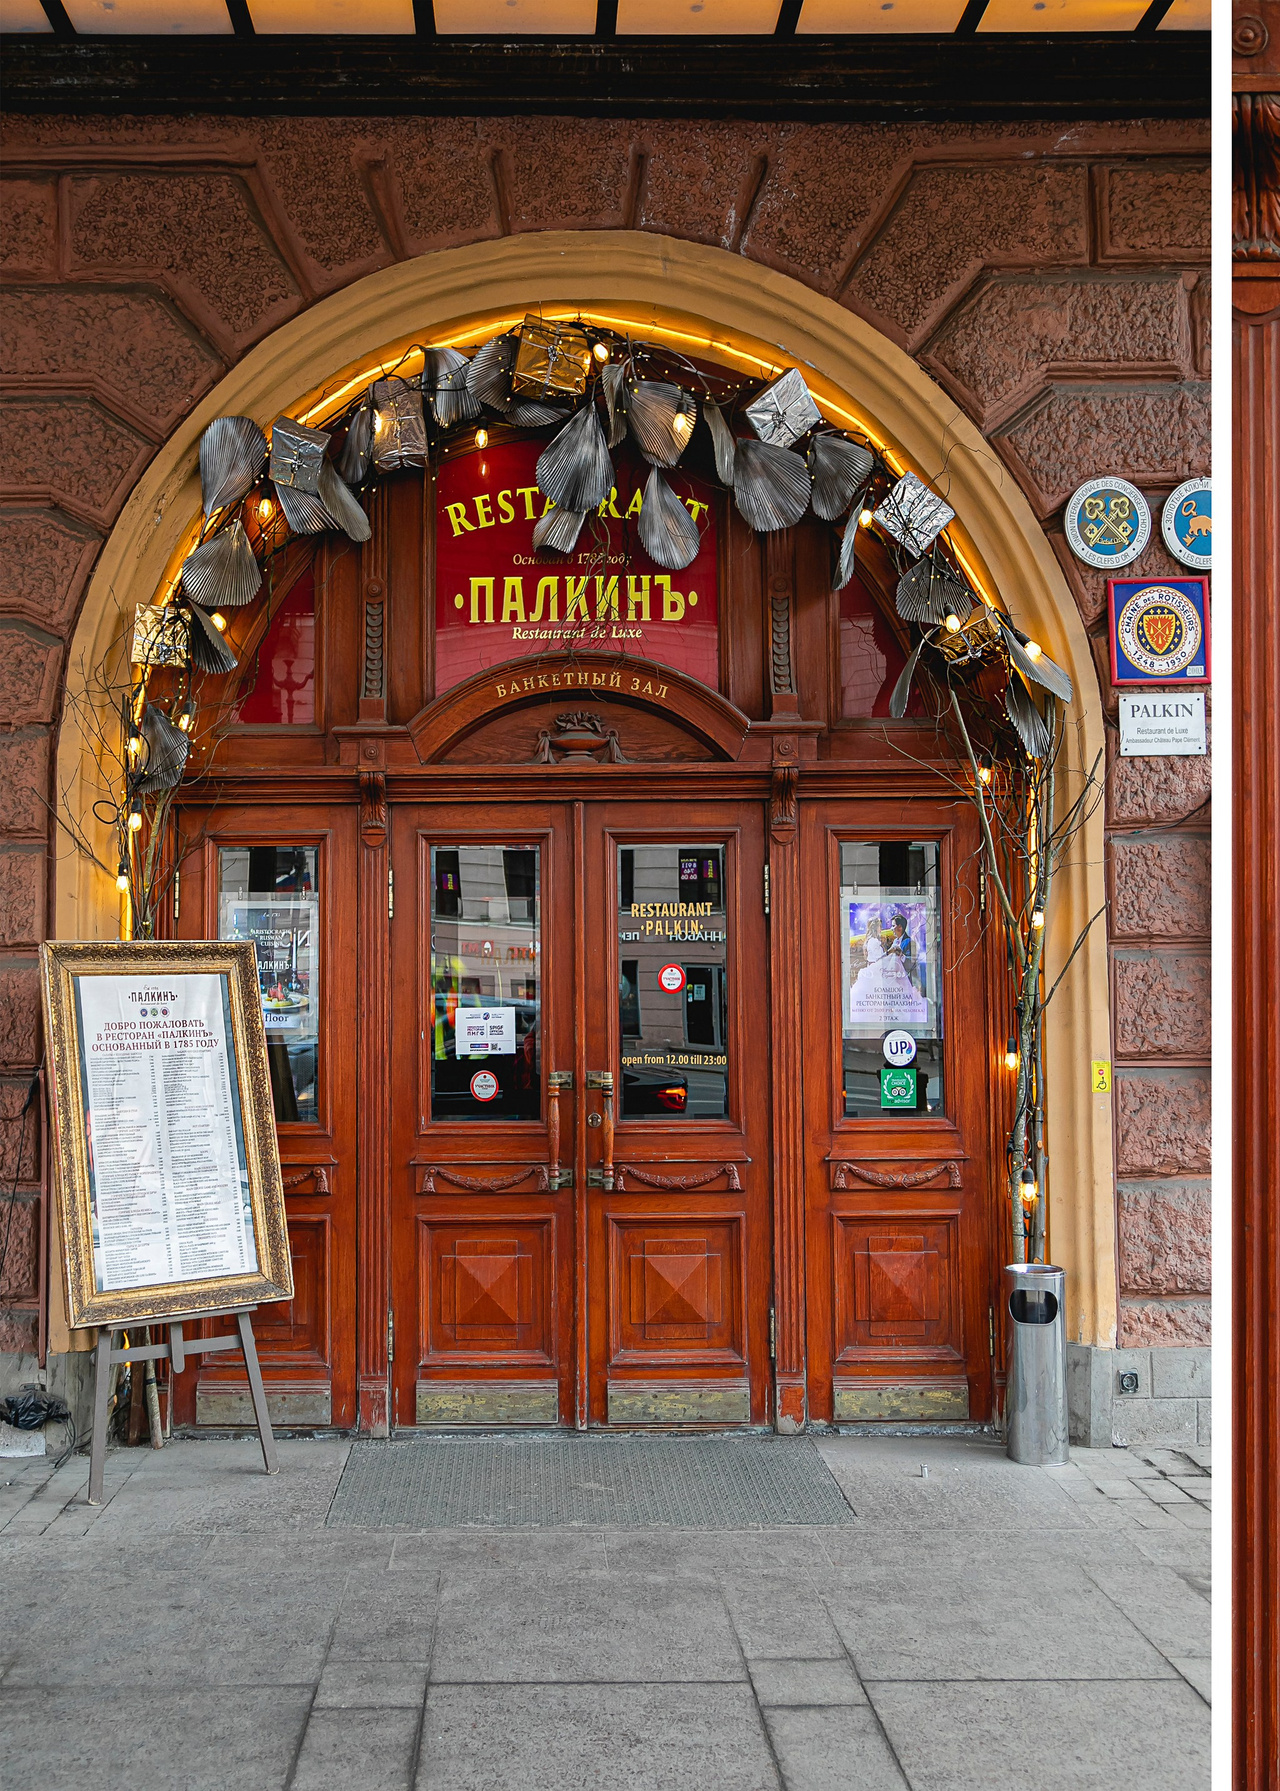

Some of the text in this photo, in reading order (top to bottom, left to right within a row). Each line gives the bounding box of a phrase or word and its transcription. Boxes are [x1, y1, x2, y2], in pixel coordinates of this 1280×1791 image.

[1101, 480, 1113, 488] DES
[1069, 481, 1101, 524] INTERNATIONALE
[1114, 481, 1144, 510] CONCIERGES
[1165, 481, 1209, 524] ЗОЛОТЫЕ КЛЮЧИ
[1069, 524, 1081, 547] UNION
[1085, 550, 1131, 565] LES CLEFS D'OR
[1182, 551, 1195, 562] LES
[1124, 602, 1141, 634] CHAINE
[1158, 593, 1195, 632] ROTISSEURS
[512, 625, 643, 640] Restaurant de Luxe
[1133, 650, 1187, 668] 1248 1950
[495, 671, 669, 699] БАНКЕТНЫЙ ЗАЛ
[1130, 703, 1194, 718] PALKIN
[1136, 727, 1189, 735] Restaurant de Luxe
[631, 902, 713, 918] RESTAURANT
[258, 960, 290, 970] АЛКИНЪ
[264, 1012, 289, 1022] floor
[103, 1019, 205, 1032] ДОБРО ПОЖАЛОВАТЬ
[96, 1029, 214, 1041] В РЕСТОРАН «ПАЛКИНЪ»
[91, 1039, 220, 1053] ОСНОВАННЫЙ В 1785 ГОДУ
[889, 1040, 908, 1055] UP
[621, 1054, 727, 1067] open from 12.00 till 23:00
